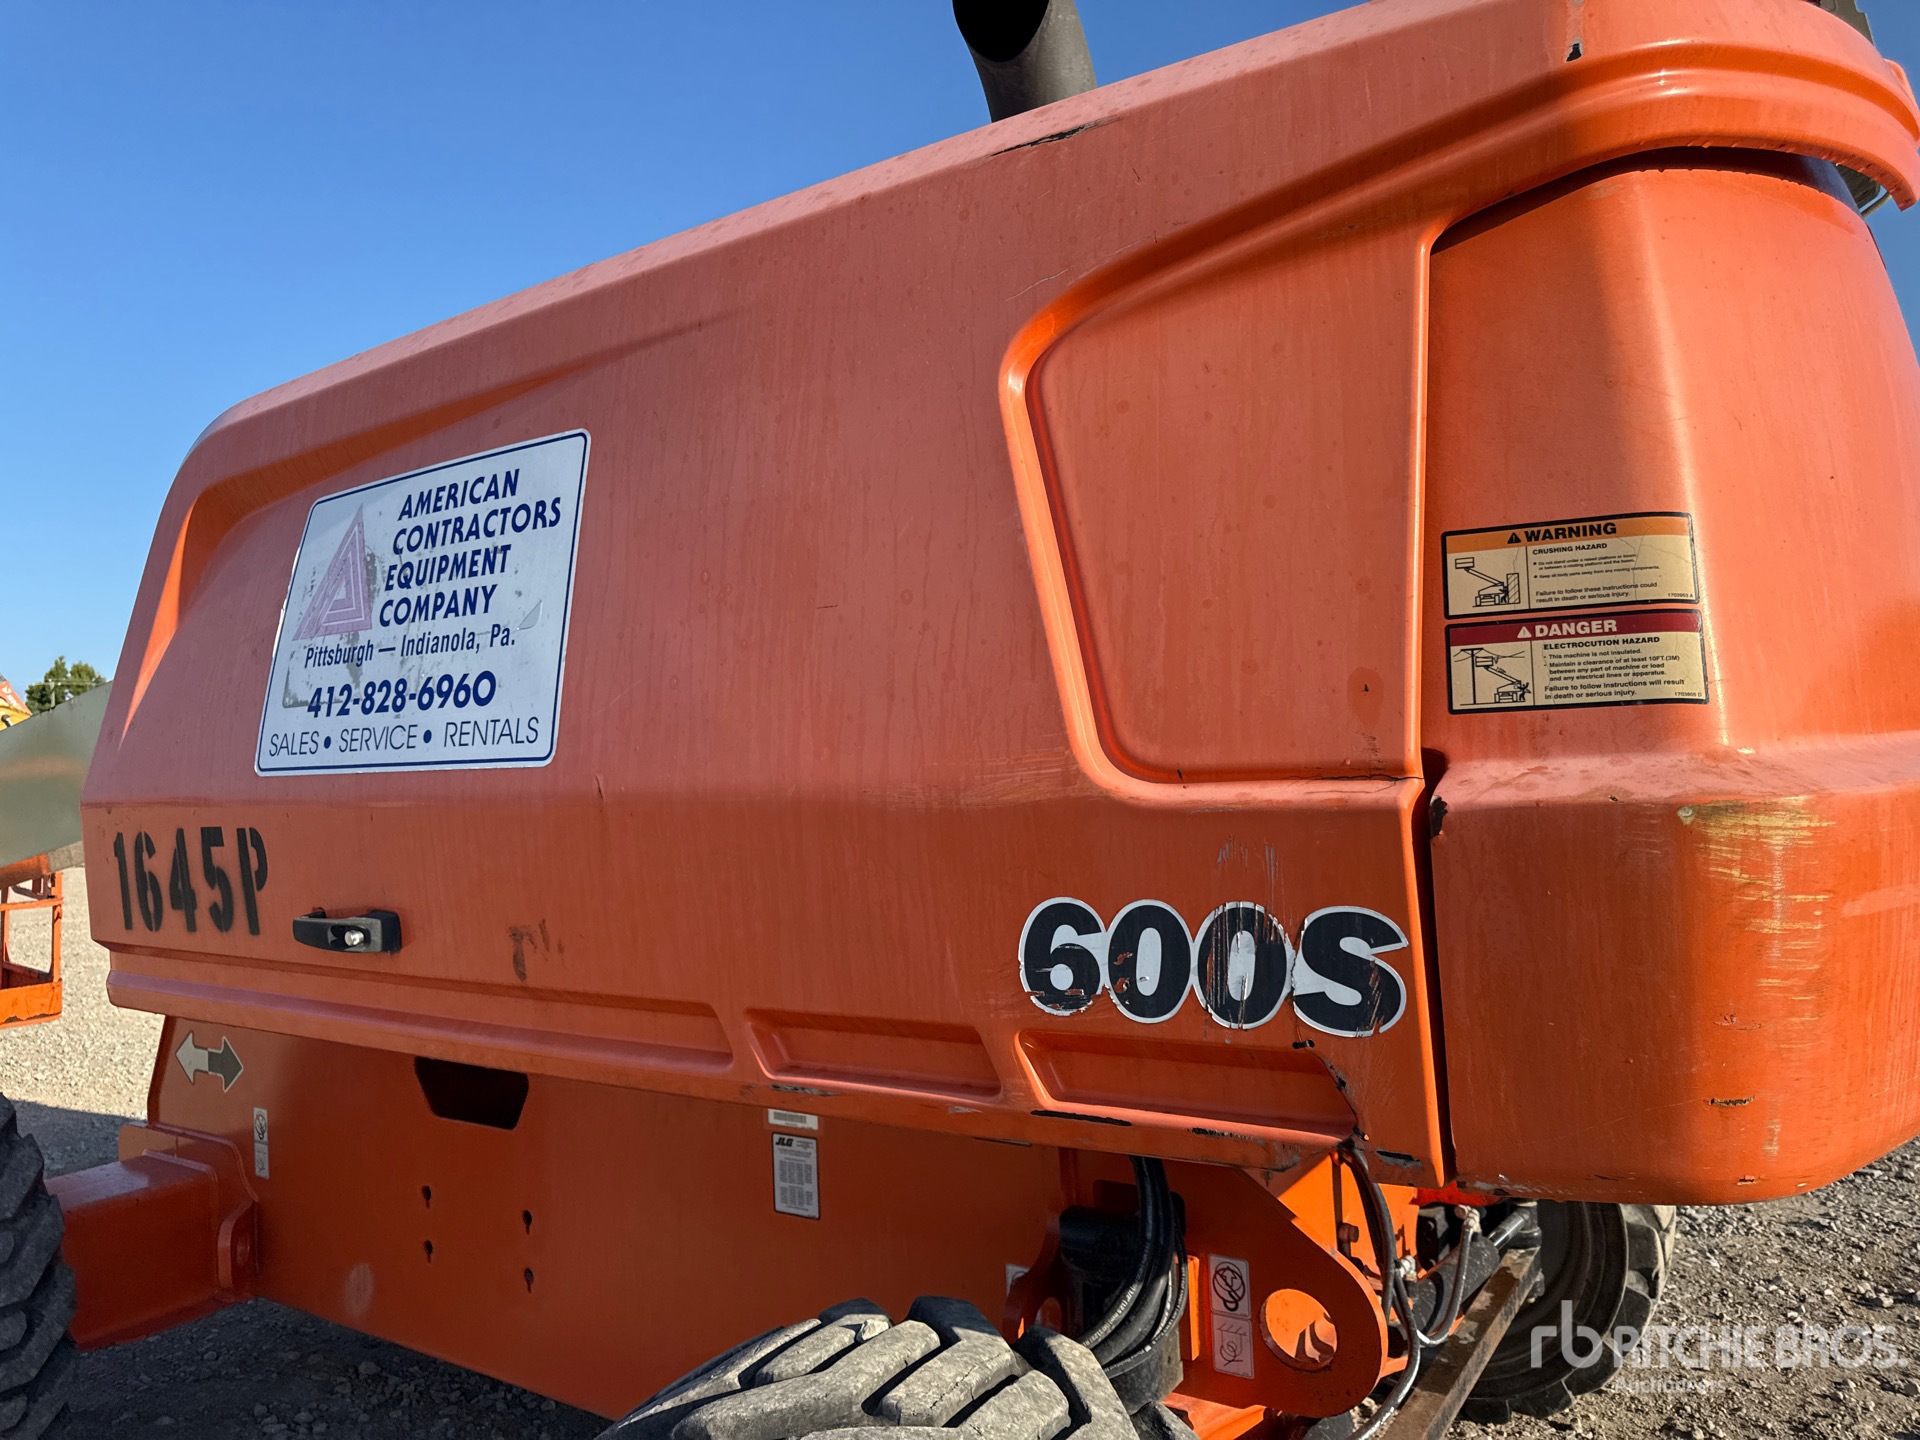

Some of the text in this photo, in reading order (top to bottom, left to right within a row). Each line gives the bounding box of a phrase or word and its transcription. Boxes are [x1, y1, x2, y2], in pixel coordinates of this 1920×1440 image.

[397, 468, 519, 521] AMERICAN
[392, 497, 561, 555] CONTRACTORS
[1524, 522, 1616, 543] WARNING
[385, 544, 511, 591] EQUIPMENT
[1533, 543, 1607, 555] CRUSHING HAZARD
[379, 584, 497, 627] COMPANY
[305, 639, 373, 668] Pittsburgh
[401, 628, 480, 657] Indianola,
[489, 624, 515, 648] Pa.
[1535, 620, 1617, 638] DANGER
[1544, 640, 1619, 650] ELECTROCUTION
[1576, 672, 1605, 680] electrical
[1590, 666, 1603, 674] part
[307, 670, 496, 718] 412-828-6960
[269, 717, 538, 757] SALES SERVICE RENTALS
[113, 826, 268, 935] 1645P
[1018, 896, 1409, 1037] 600S
